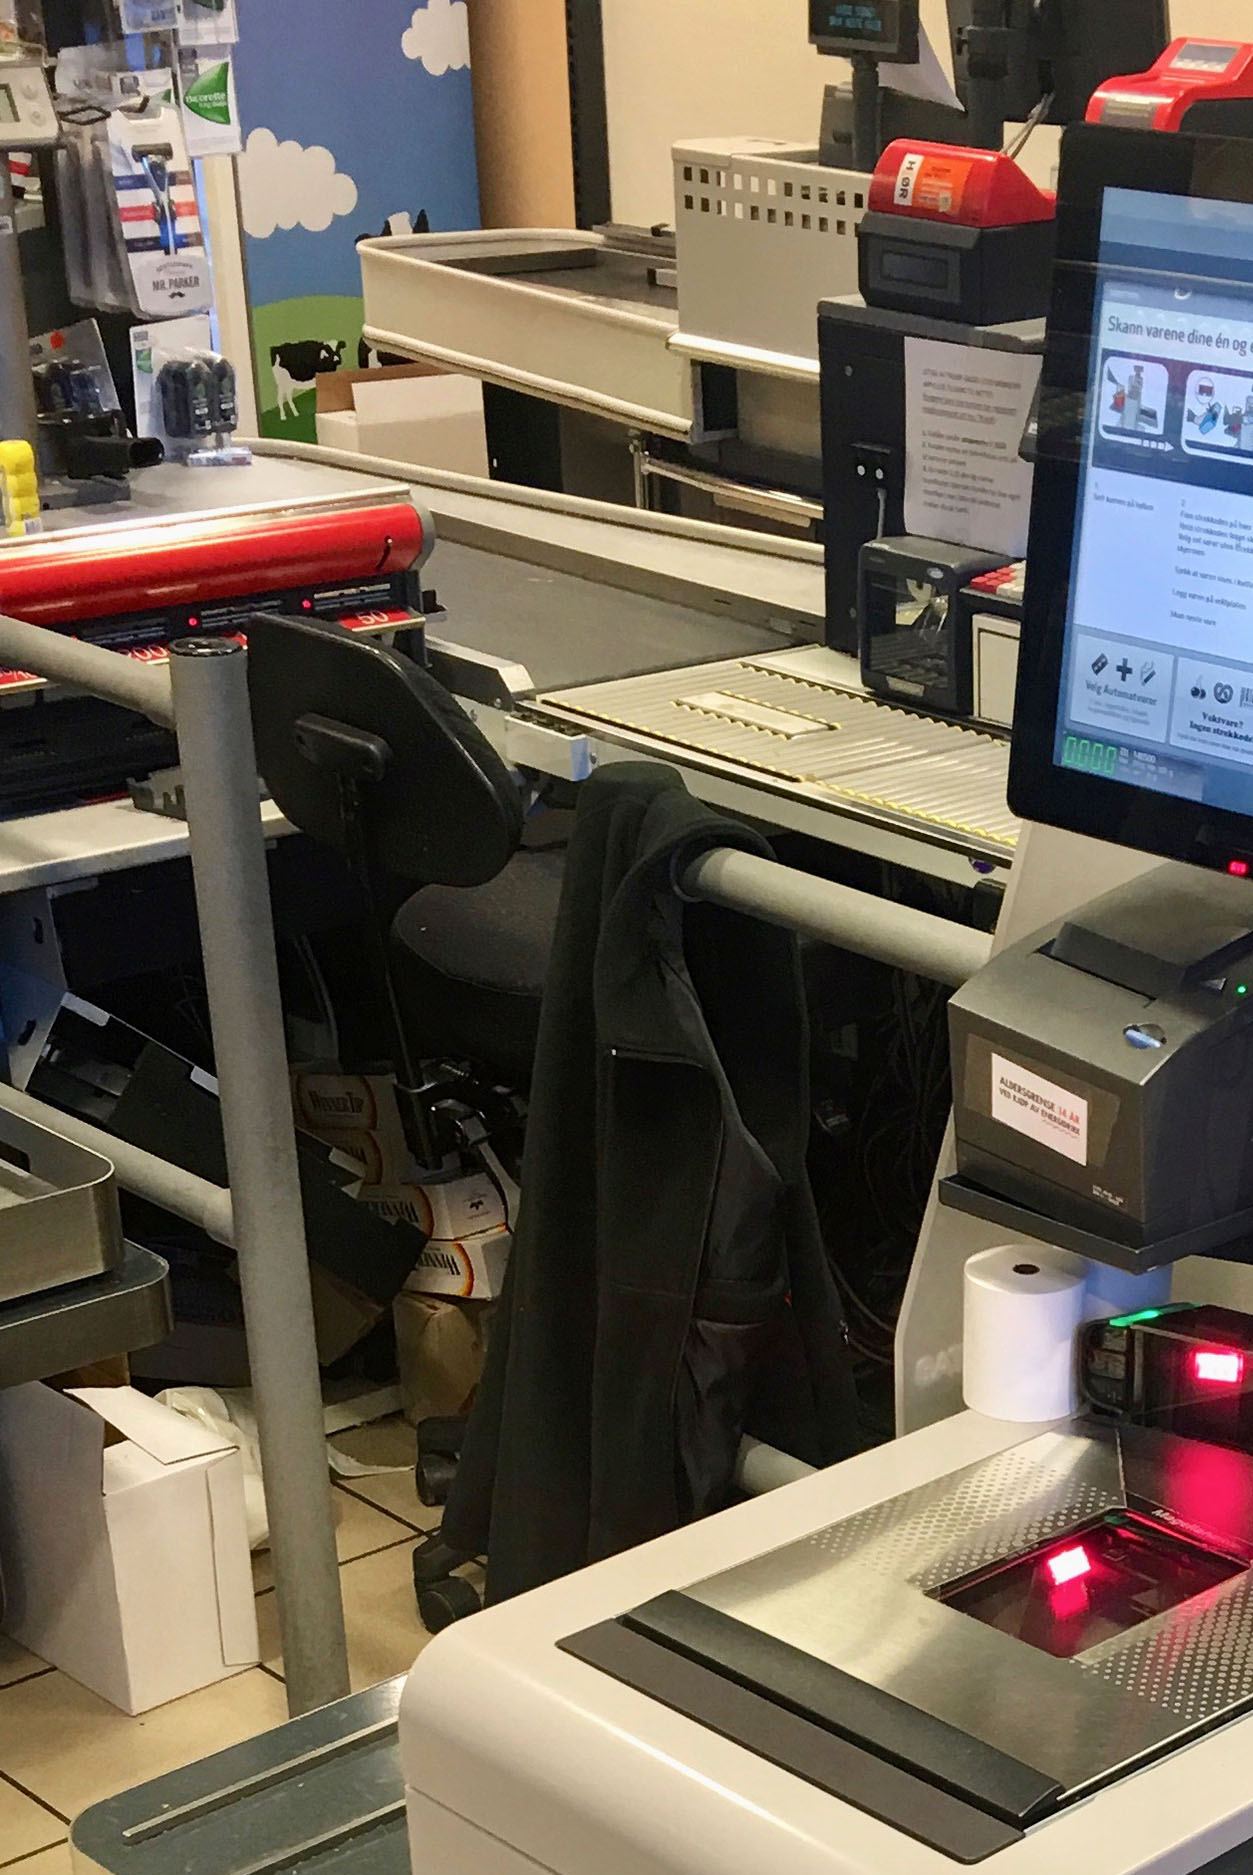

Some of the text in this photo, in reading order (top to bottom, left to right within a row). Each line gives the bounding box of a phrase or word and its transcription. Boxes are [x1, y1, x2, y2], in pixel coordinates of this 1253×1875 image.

[1107, 315, 1144, 336] Skann
[1145, 325, 1185, 343] varene
[1187, 329, 1213, 348] dine
[1215, 332, 1231, 350] én
[1232, 339, 1248, 357] og
[1189, 720, 1212, 733] Ingen
